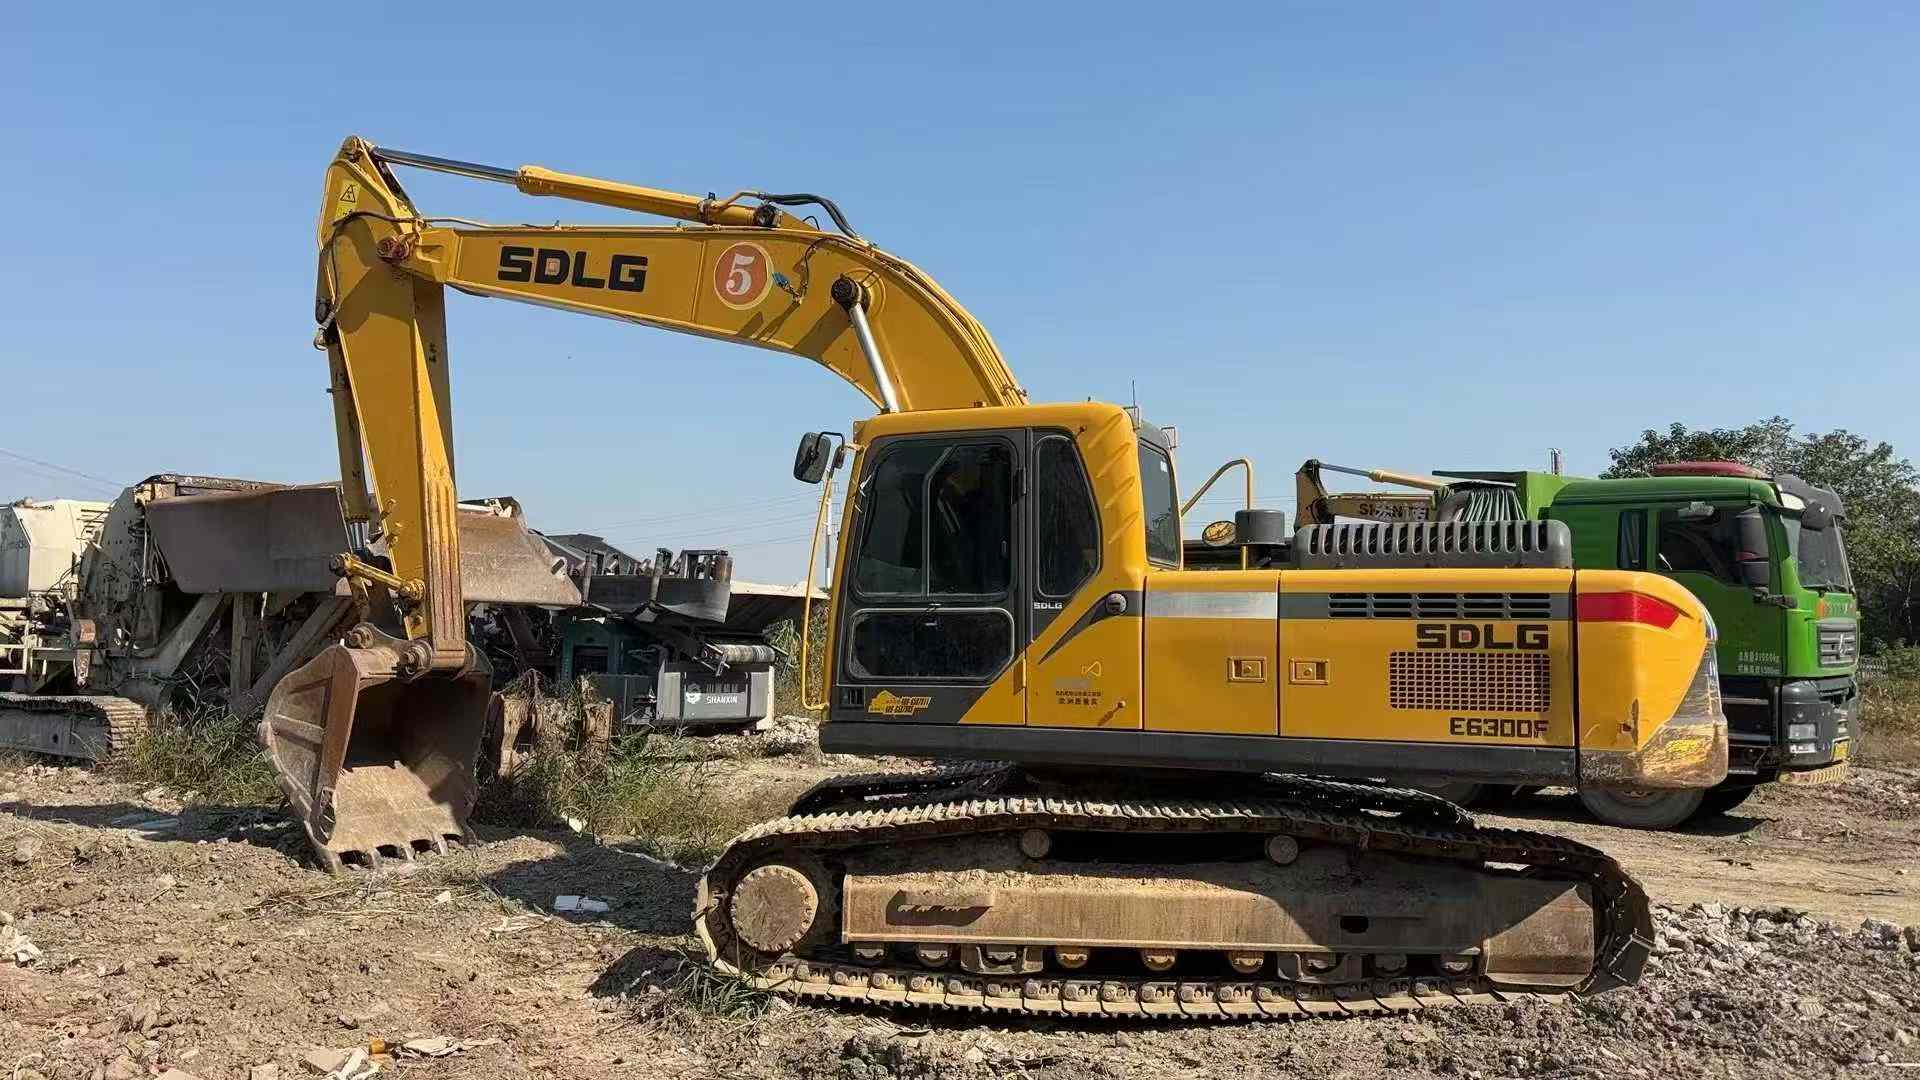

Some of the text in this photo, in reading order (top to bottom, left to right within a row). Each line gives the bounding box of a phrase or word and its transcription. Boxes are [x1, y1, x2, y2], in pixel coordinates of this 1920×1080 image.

[498, 246, 648, 292] SDLG
[725, 253, 755, 296] 5
[1033, 601, 1063, 610] SDLG
[1416, 623, 1549, 650] SDLG
[706, 695, 738, 705] SHANXIN
[1449, 717, 1549, 738] E6300F
